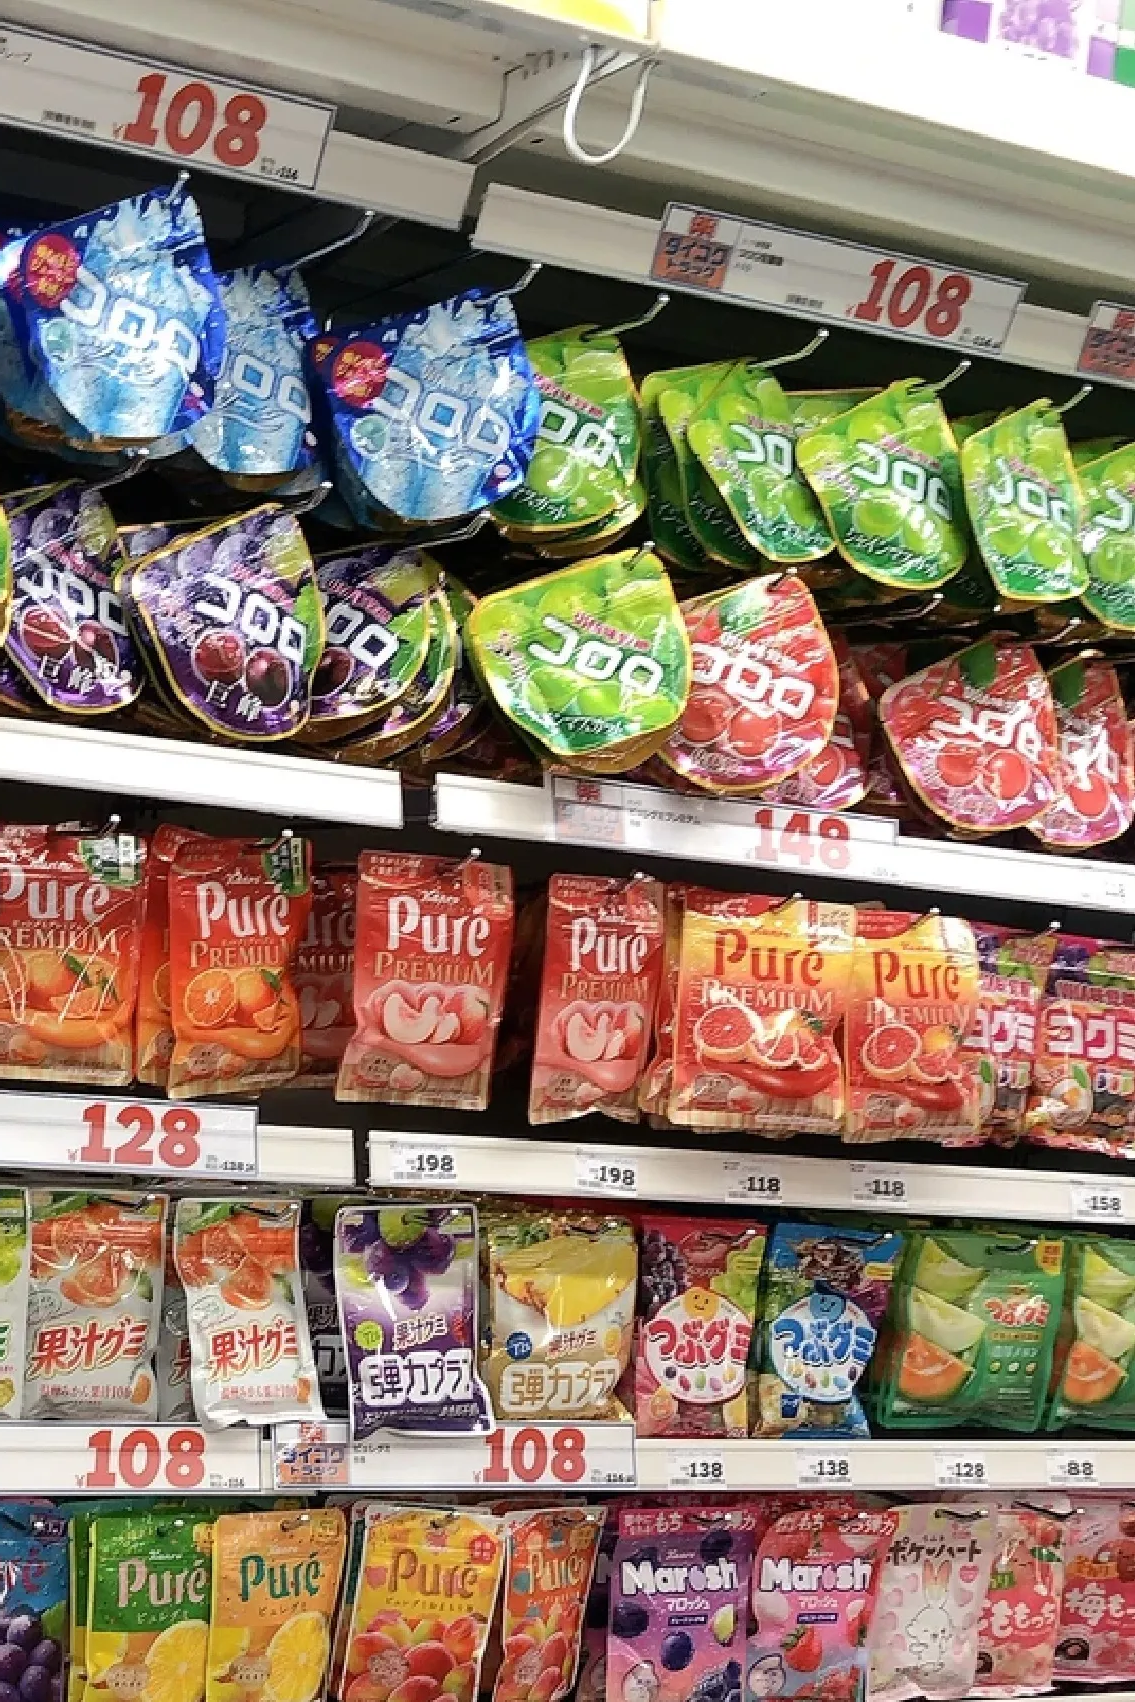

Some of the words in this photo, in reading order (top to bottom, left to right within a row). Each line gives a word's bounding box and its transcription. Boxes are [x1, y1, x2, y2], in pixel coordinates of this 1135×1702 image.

[61, 265, 201, 374] コロロ
[217, 353, 311, 424] ロロ
[372, 367, 510, 455] コロロ
[729, 423, 794, 478] コロ
[192, 577, 308, 666] コロロ
[527, 615, 664, 698] コロロ
[691, 642, 816, 720] コロロ
[386, 895, 491, 957] Puré
[374, 951, 496, 987] PREMIUM
[713, 928, 824, 987] Puré
[560, 972, 648, 1002] PREMIUM
[700, 978, 834, 1013] PREMIUM
[415, 1154, 455, 1172] 198
[598, 1164, 635, 1186] 198
[746, 1176, 782, 1193] 118
[28, 1318, 148, 1380] 果汁グミ
[208, 1319, 298, 1379] 果汁グミ
[394, 1313, 447, 1350] 果汁グミ
[648, 1319, 751, 1366] つぶグミ
[773, 1319, 877, 1366] つぶグミ
[688, 1461, 724, 1478] 138
[815, 1460, 850, 1477] 138
[953, 1462, 985, 1478] 128
[1065, 1459, 1095, 1477] 88
[117, 1558, 207, 1609] Puré
[239, 1552, 322, 1603] Puré
[387, 1548, 479, 1600] Puré
[621, 1557, 739, 1596] Marosh
[758, 1556, 872, 1593] Marosh
